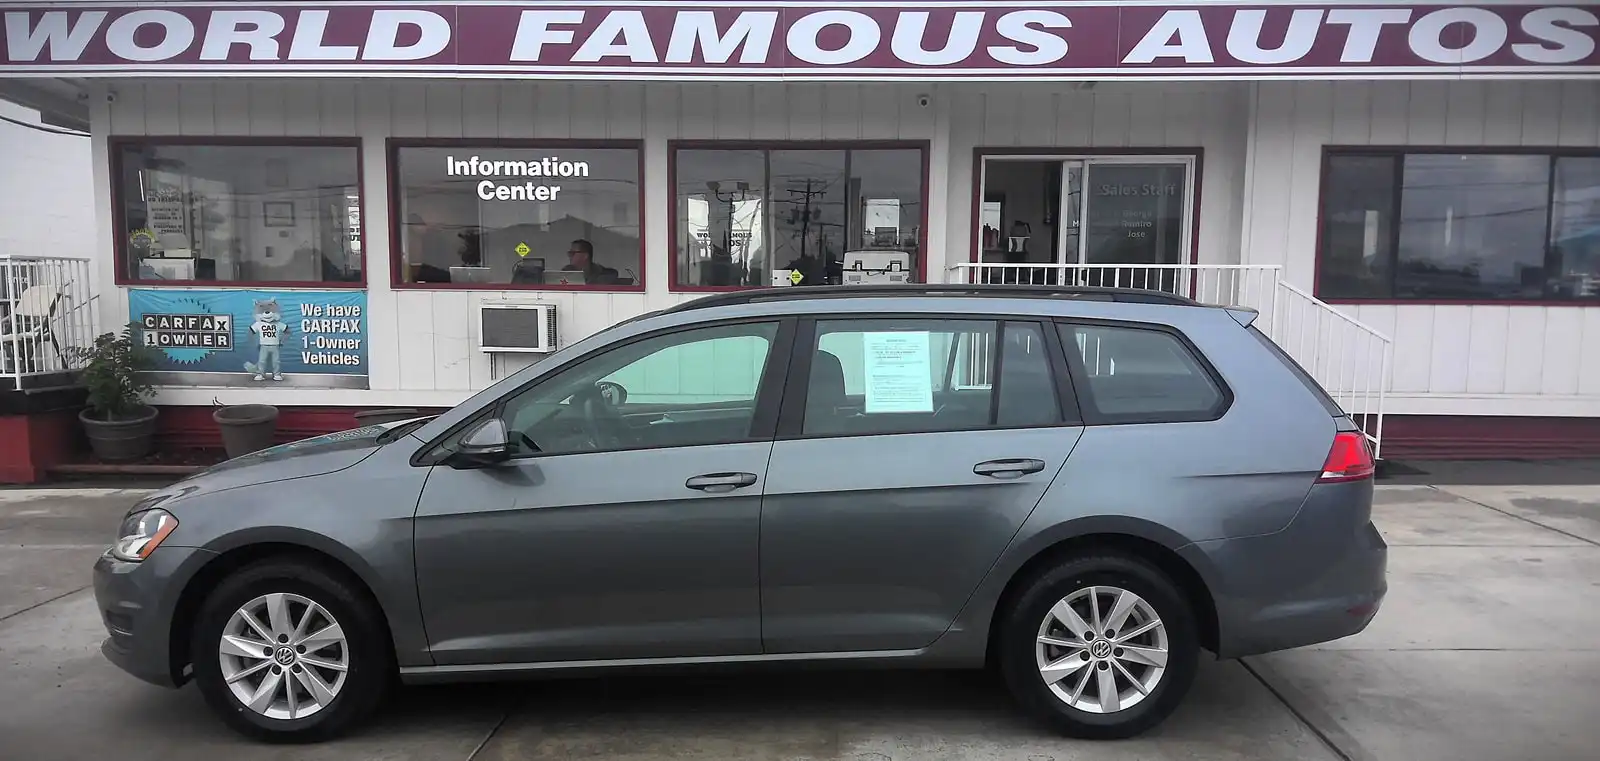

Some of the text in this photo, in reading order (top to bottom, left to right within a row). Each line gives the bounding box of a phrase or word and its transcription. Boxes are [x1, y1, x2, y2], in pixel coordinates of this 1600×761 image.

[4, 7, 1596, 66] WORLD FAMOUS AUTOS
[447, 155, 589, 177] Information
[477, 180, 561, 201] Center
[1102, 182, 1176, 196] Sales Staff
[300, 303, 361, 317] We have
[144, 316, 230, 332] CARFAX
[300, 318, 361, 333] CARFAX
[146, 333, 227, 346] 1 OWNER
[262, 331, 277, 339] FOX
[301, 335, 361, 350] 1-Owner
[301, 351, 361, 366] Vehicles
